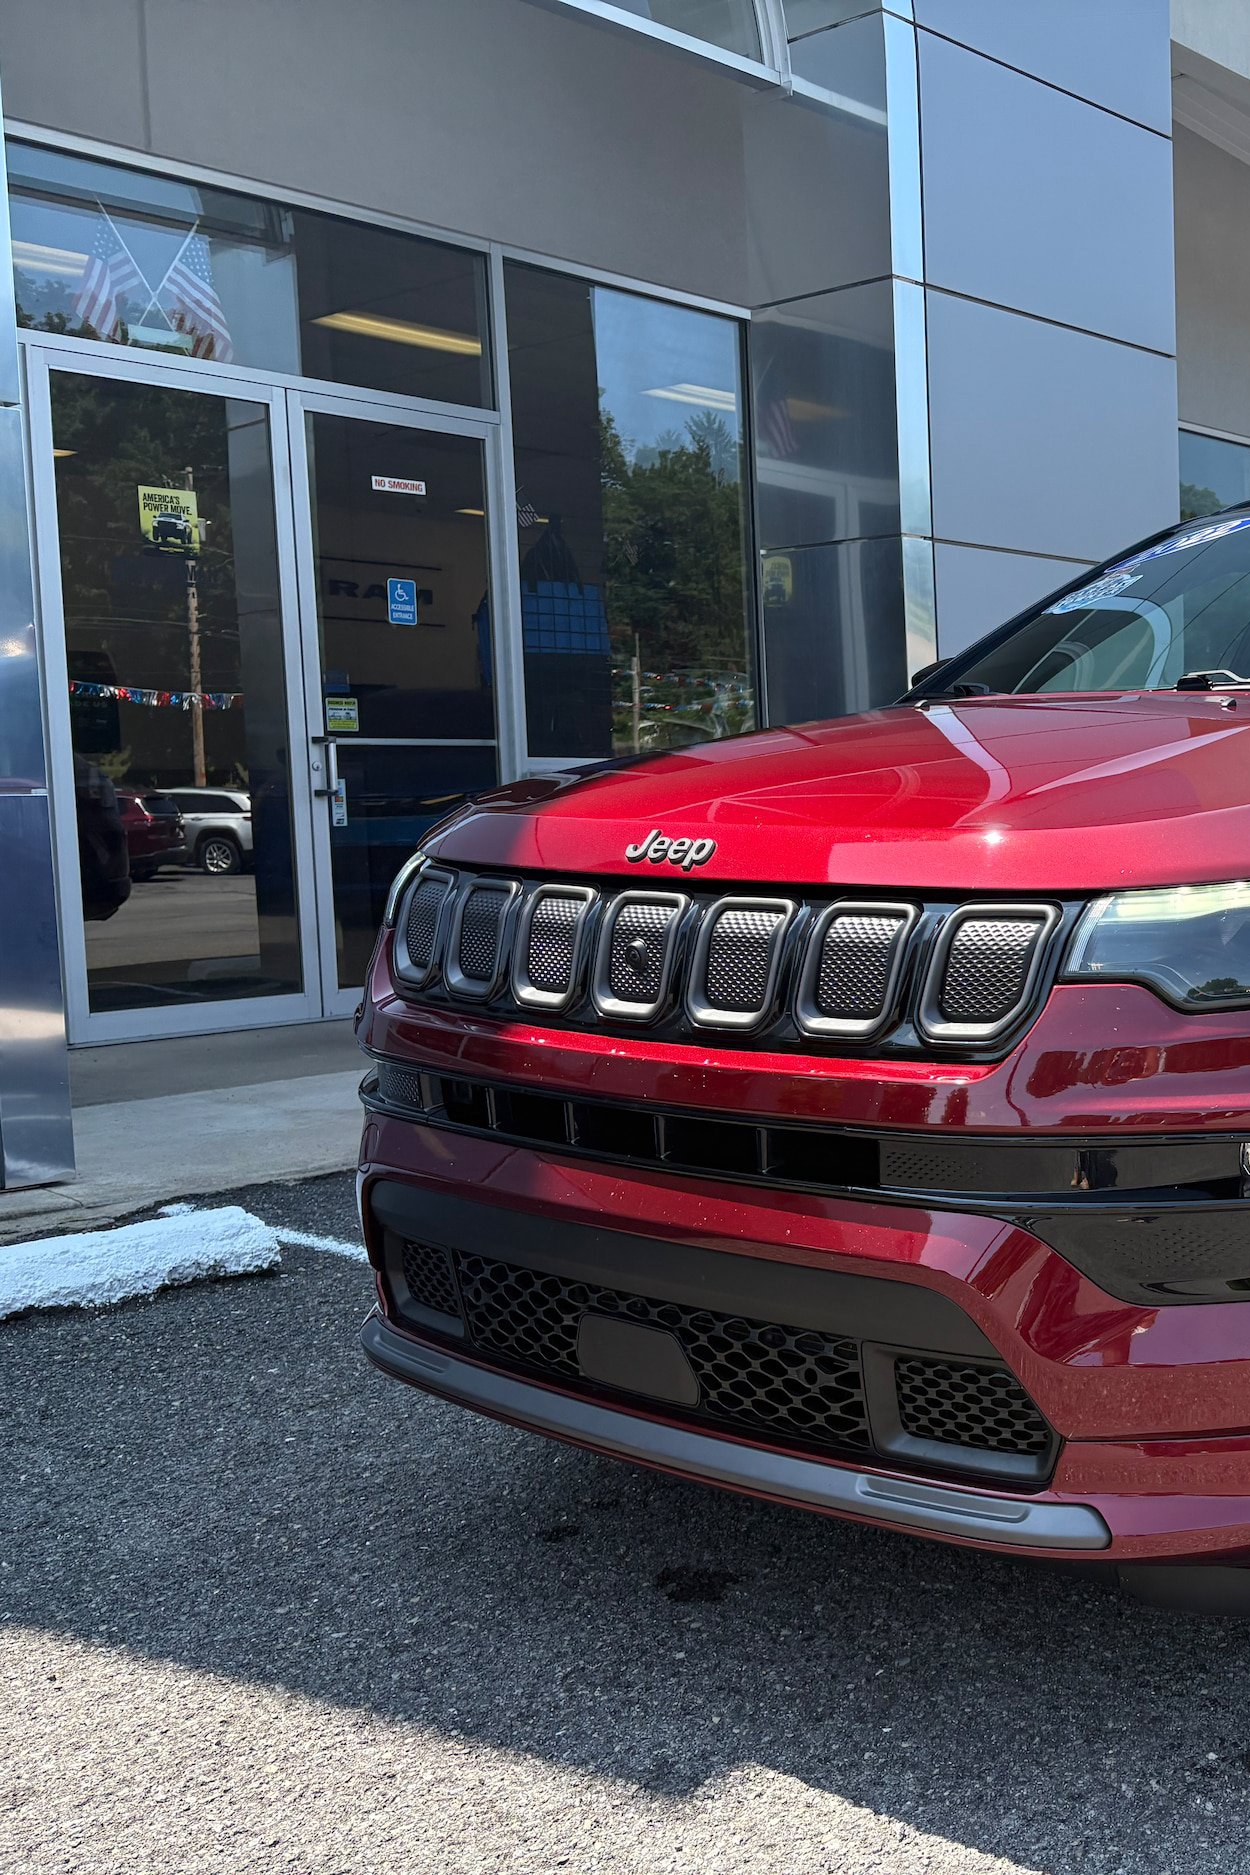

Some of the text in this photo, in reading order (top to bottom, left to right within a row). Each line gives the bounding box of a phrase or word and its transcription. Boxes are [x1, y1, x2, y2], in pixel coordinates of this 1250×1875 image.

[374, 478, 423, 492] NO SMOKING
[142, 492, 181, 505] AMERICA'S
[143, 501, 193, 516] POWER MOVE.
[625, 828, 718, 873] Jeep
